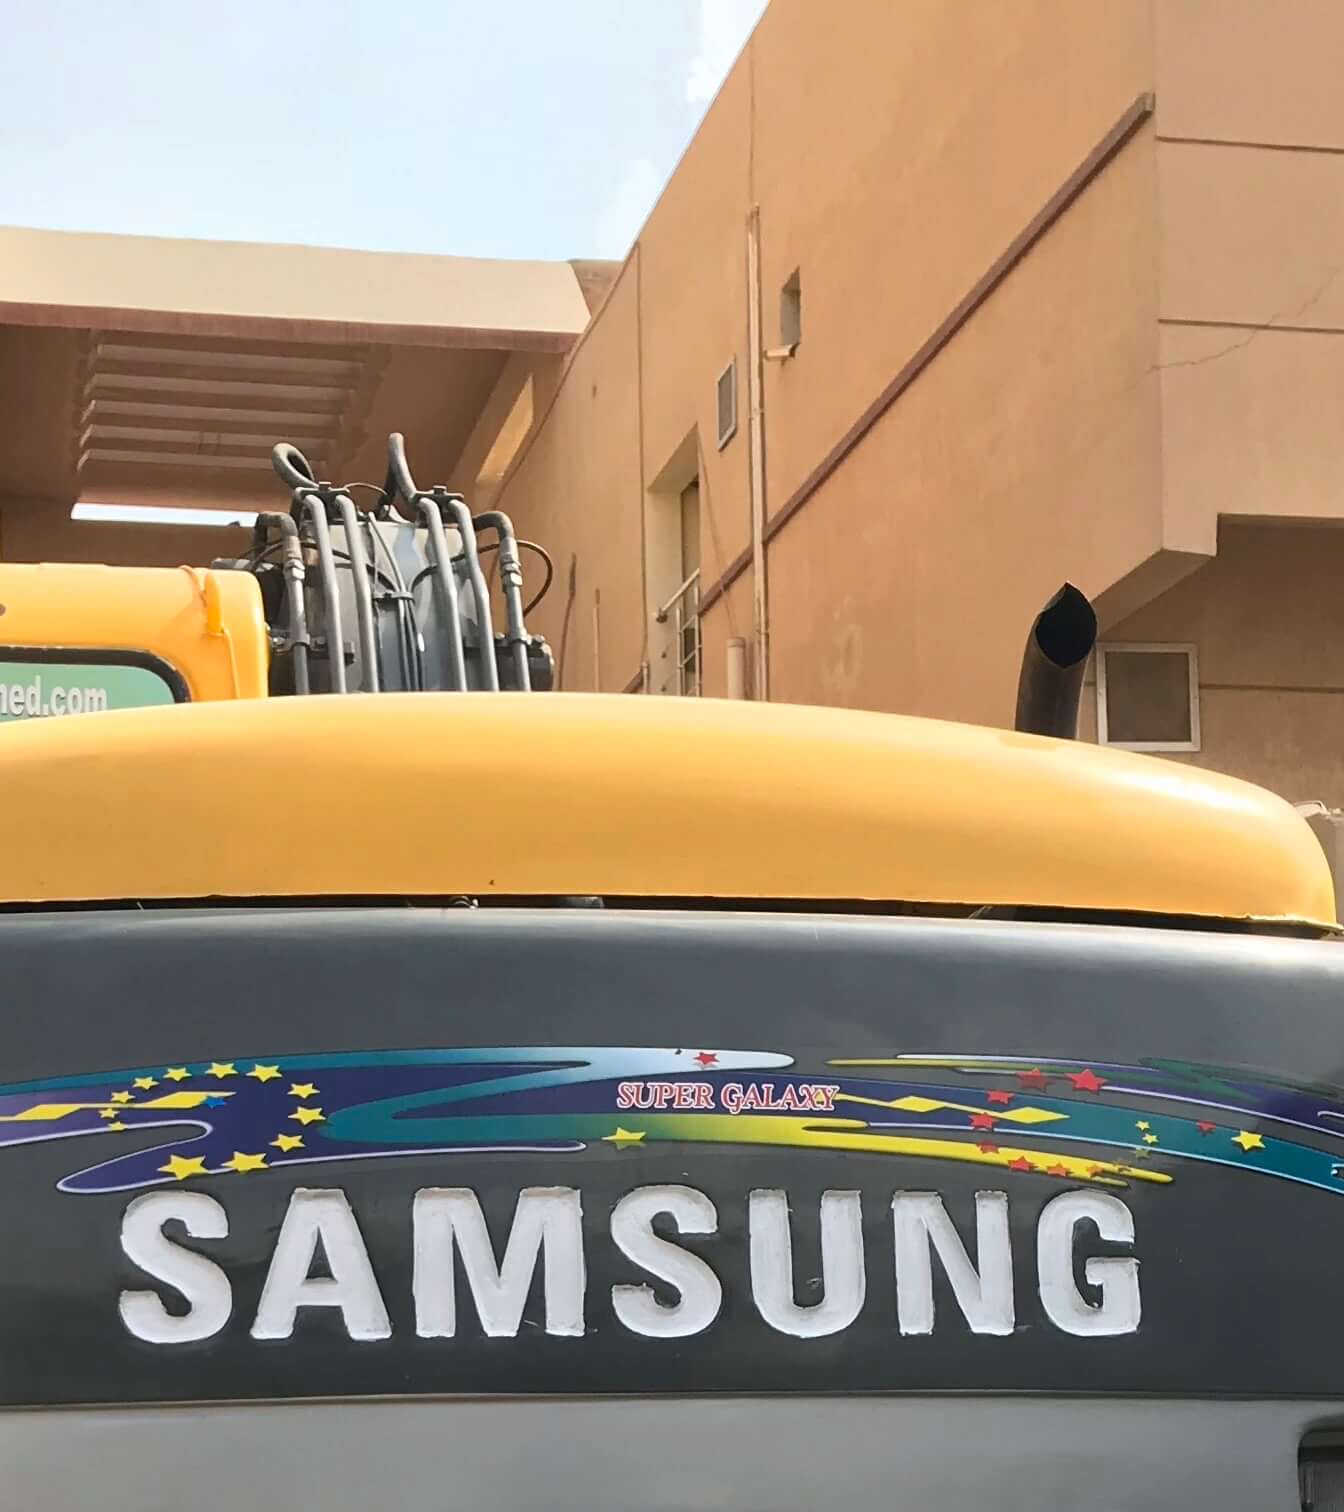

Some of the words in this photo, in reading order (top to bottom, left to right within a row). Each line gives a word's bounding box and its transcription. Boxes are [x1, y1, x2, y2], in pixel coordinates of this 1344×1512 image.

[617, 1082, 716, 1109] SUPER
[720, 1083, 841, 1114] GALAXY
[119, 1186, 1142, 1343] SAMSUNG
